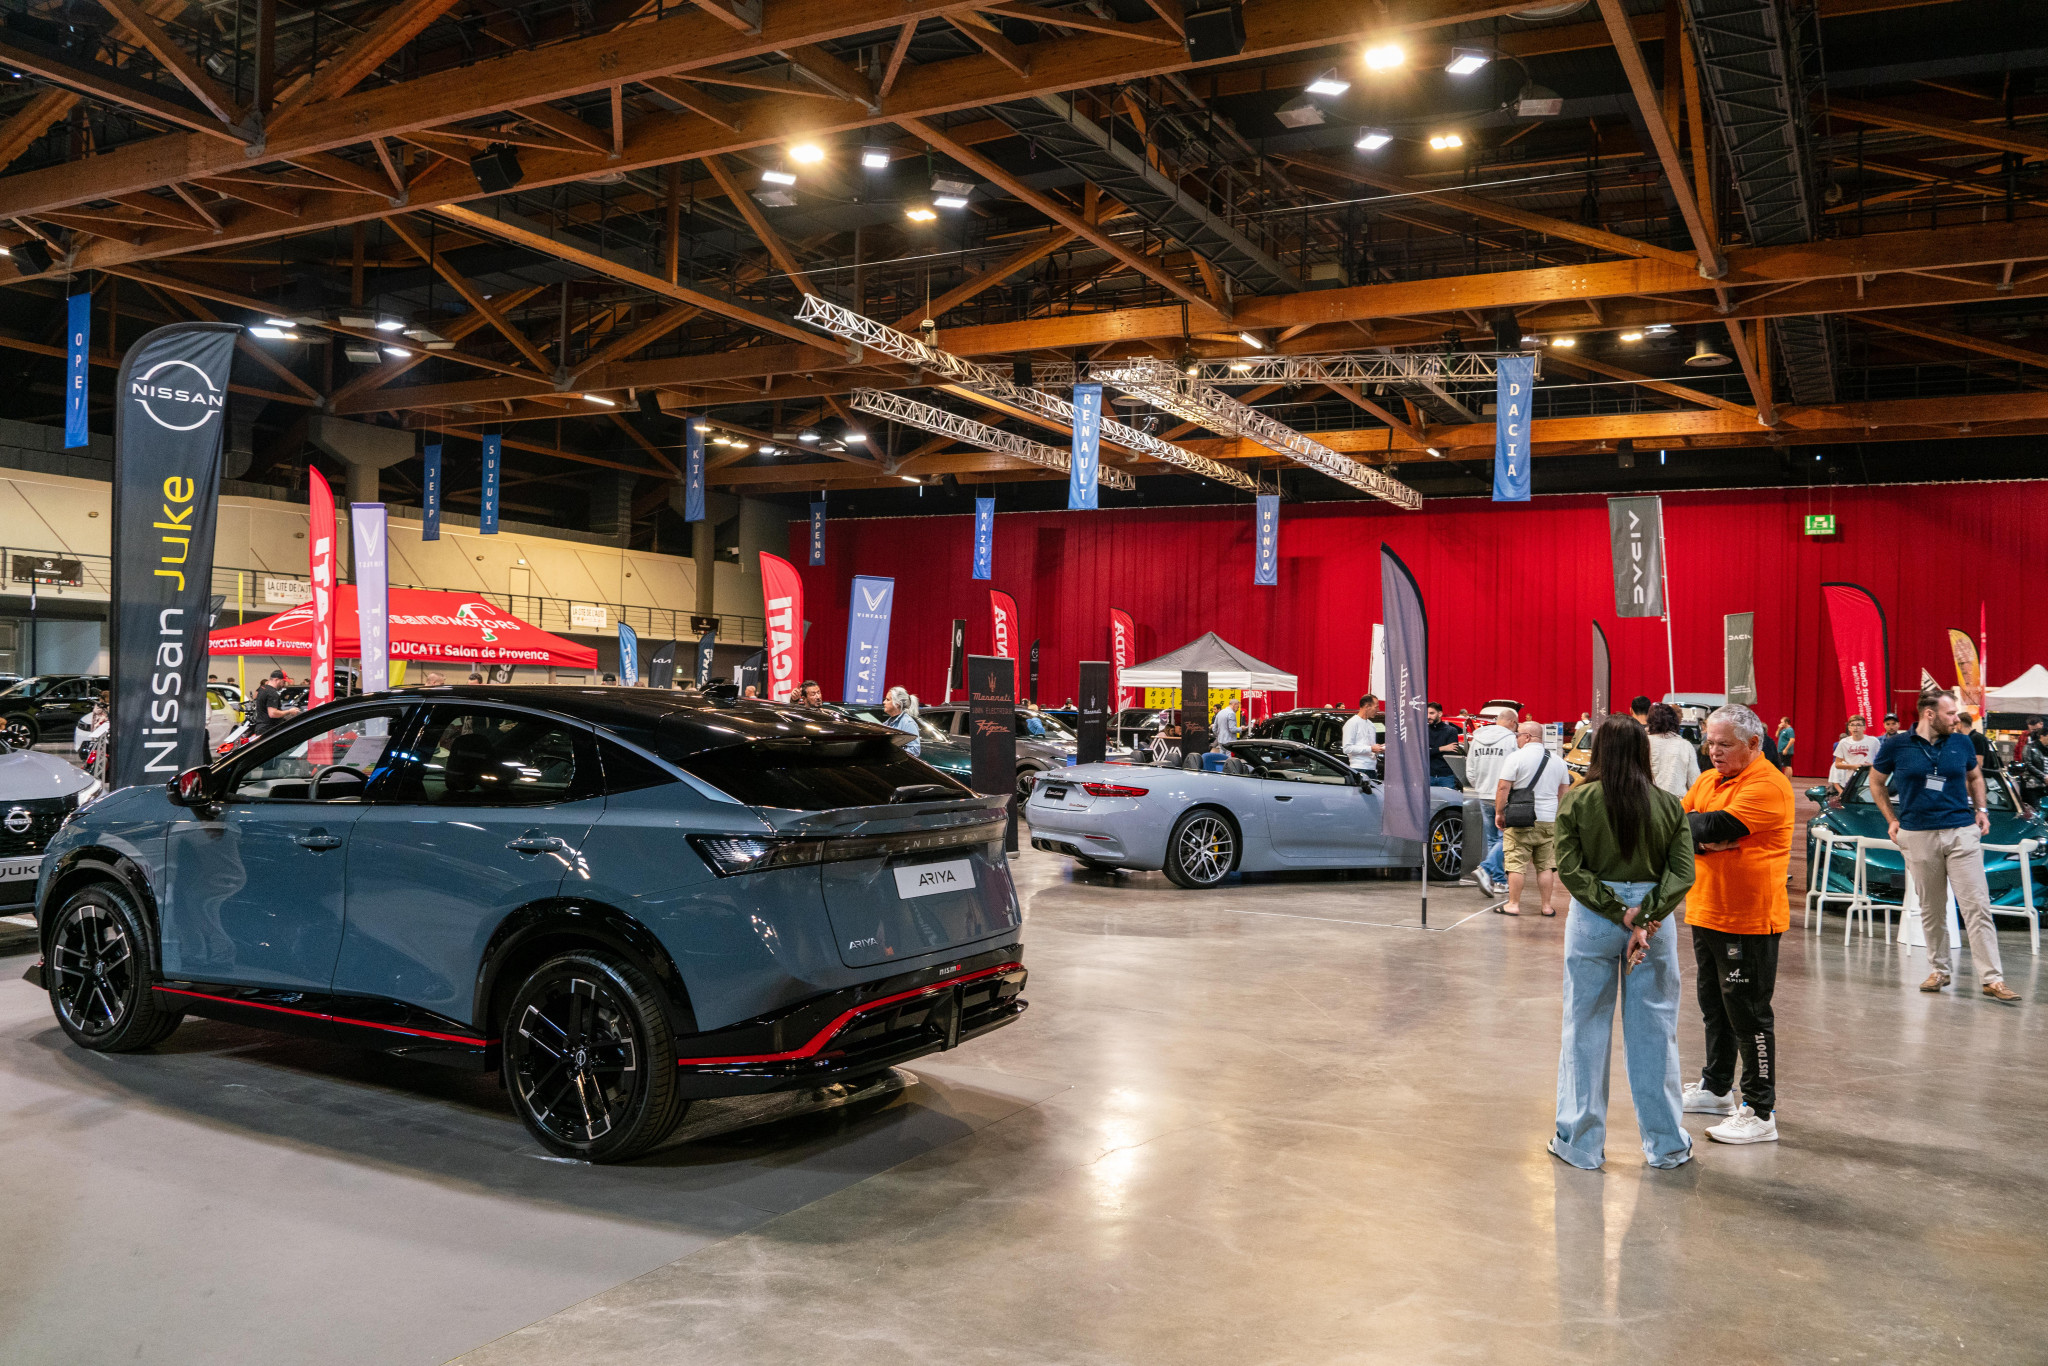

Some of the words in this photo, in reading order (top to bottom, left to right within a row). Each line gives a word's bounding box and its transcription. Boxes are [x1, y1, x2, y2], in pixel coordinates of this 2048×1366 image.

[132, 383, 223, 407] NISSAN
[1507, 383, 1520, 477] DACIA
[1080, 393, 1092, 500] RENAULT
[486, 445, 494, 524] SUZUKI
[154, 476, 195, 592] Juke
[979, 512, 988, 566] MAZDA
[1262, 512, 1271, 570] HONDA
[447, 616, 520, 630] MOTORS
[240, 638, 262, 648] Salon
[264, 638, 275, 648] de
[392, 642, 441, 656] DUCATI
[444, 644, 478, 658] Salon
[482, 646, 496, 658] de
[499, 648, 550, 660] Provence
[143, 608, 184, 772] Nissan
[1474, 748, 1504, 757] ATLANTA
[913, 833, 979, 848] NISSAN
[0, 864, 42, 878] JUK
[918, 870, 956, 887] ARIYA
[850, 937, 878, 950] ARIYA
[1756, 1044, 1767, 1057] DO
[1758, 1058, 1768, 1079] JUST
